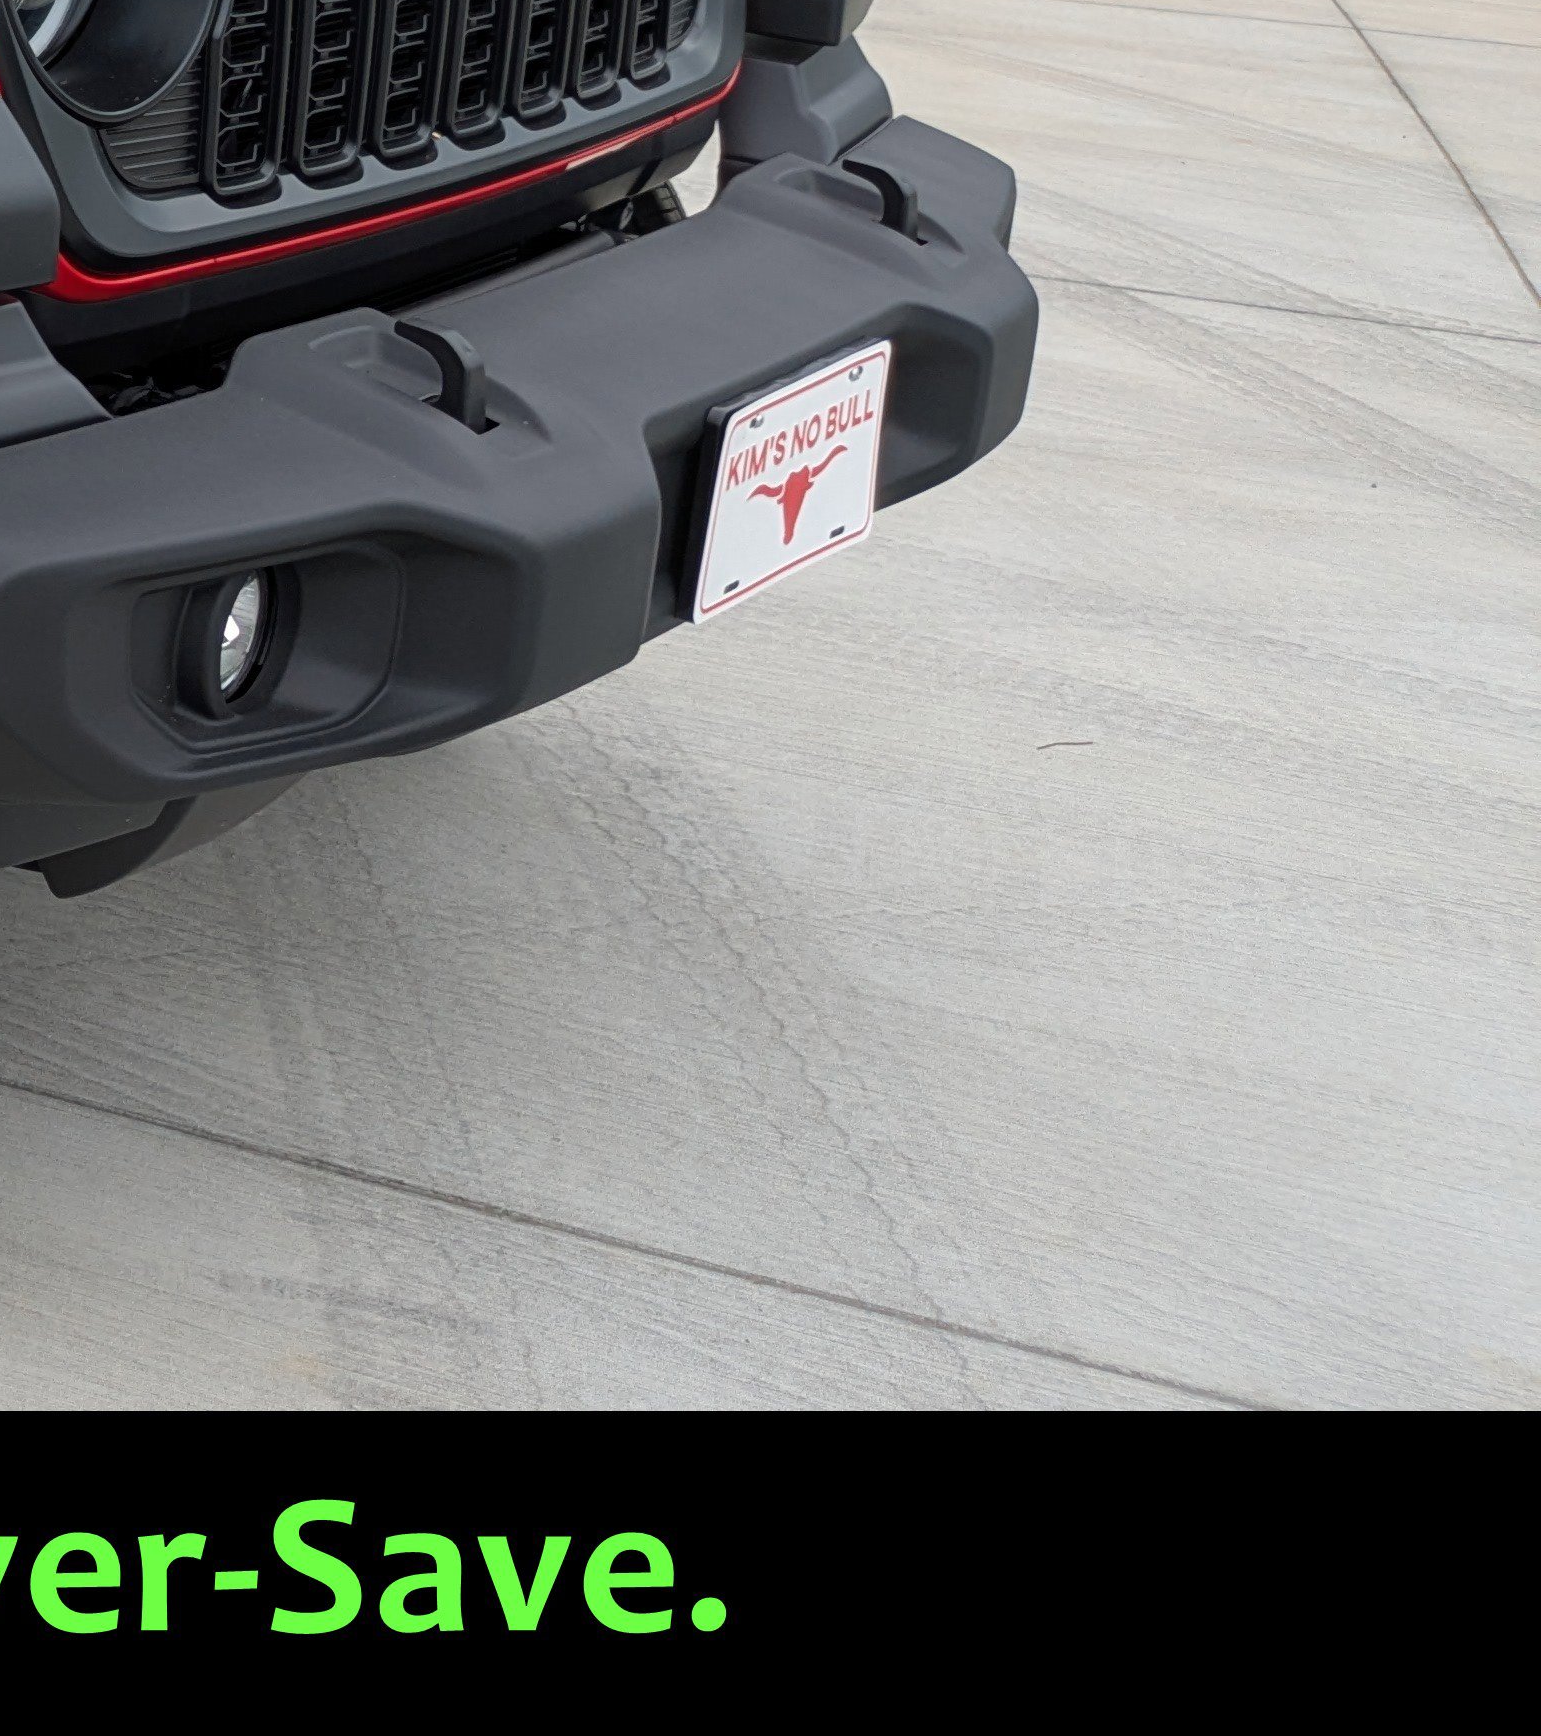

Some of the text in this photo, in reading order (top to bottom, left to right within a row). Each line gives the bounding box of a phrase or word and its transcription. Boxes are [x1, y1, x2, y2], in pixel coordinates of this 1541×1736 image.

[725, 389, 874, 492] KIM'S NO BULL
